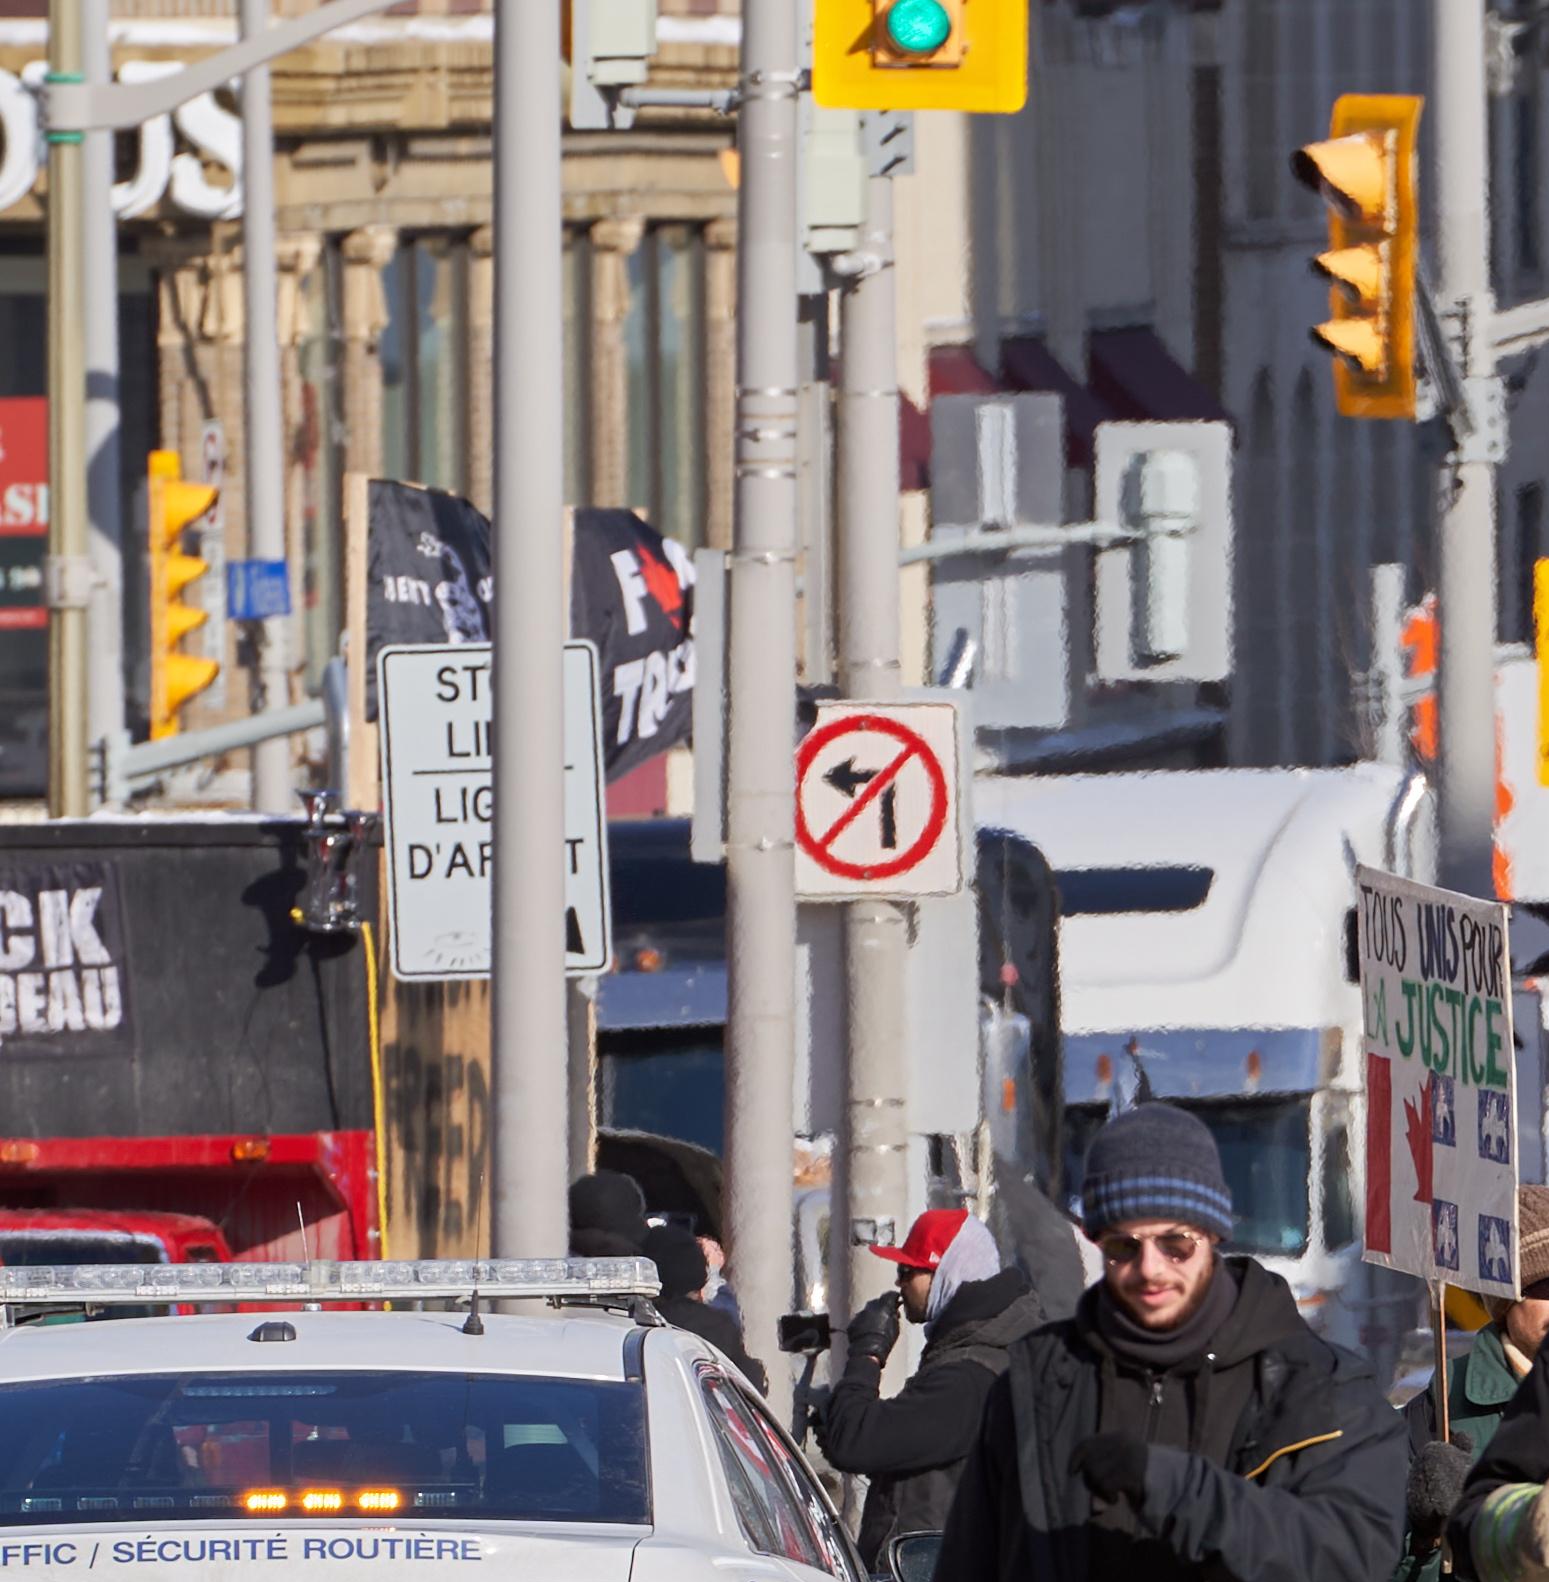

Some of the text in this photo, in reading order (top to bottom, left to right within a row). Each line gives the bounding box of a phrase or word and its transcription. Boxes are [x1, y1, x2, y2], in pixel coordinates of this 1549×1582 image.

[436, 665, 492, 702] ST
[447, 721, 492, 757] LI
[434, 786, 492, 823] LIG
[408, 838, 584, 880] D'AT
[1361, 884, 1504, 1000] TOUS UNIS POUR
[1395, 980, 1508, 1088] JUSTICE
[112, 1533, 288, 1563] SÉCURITÉ
[303, 1532, 483, 1561] ROUTIÈRE
